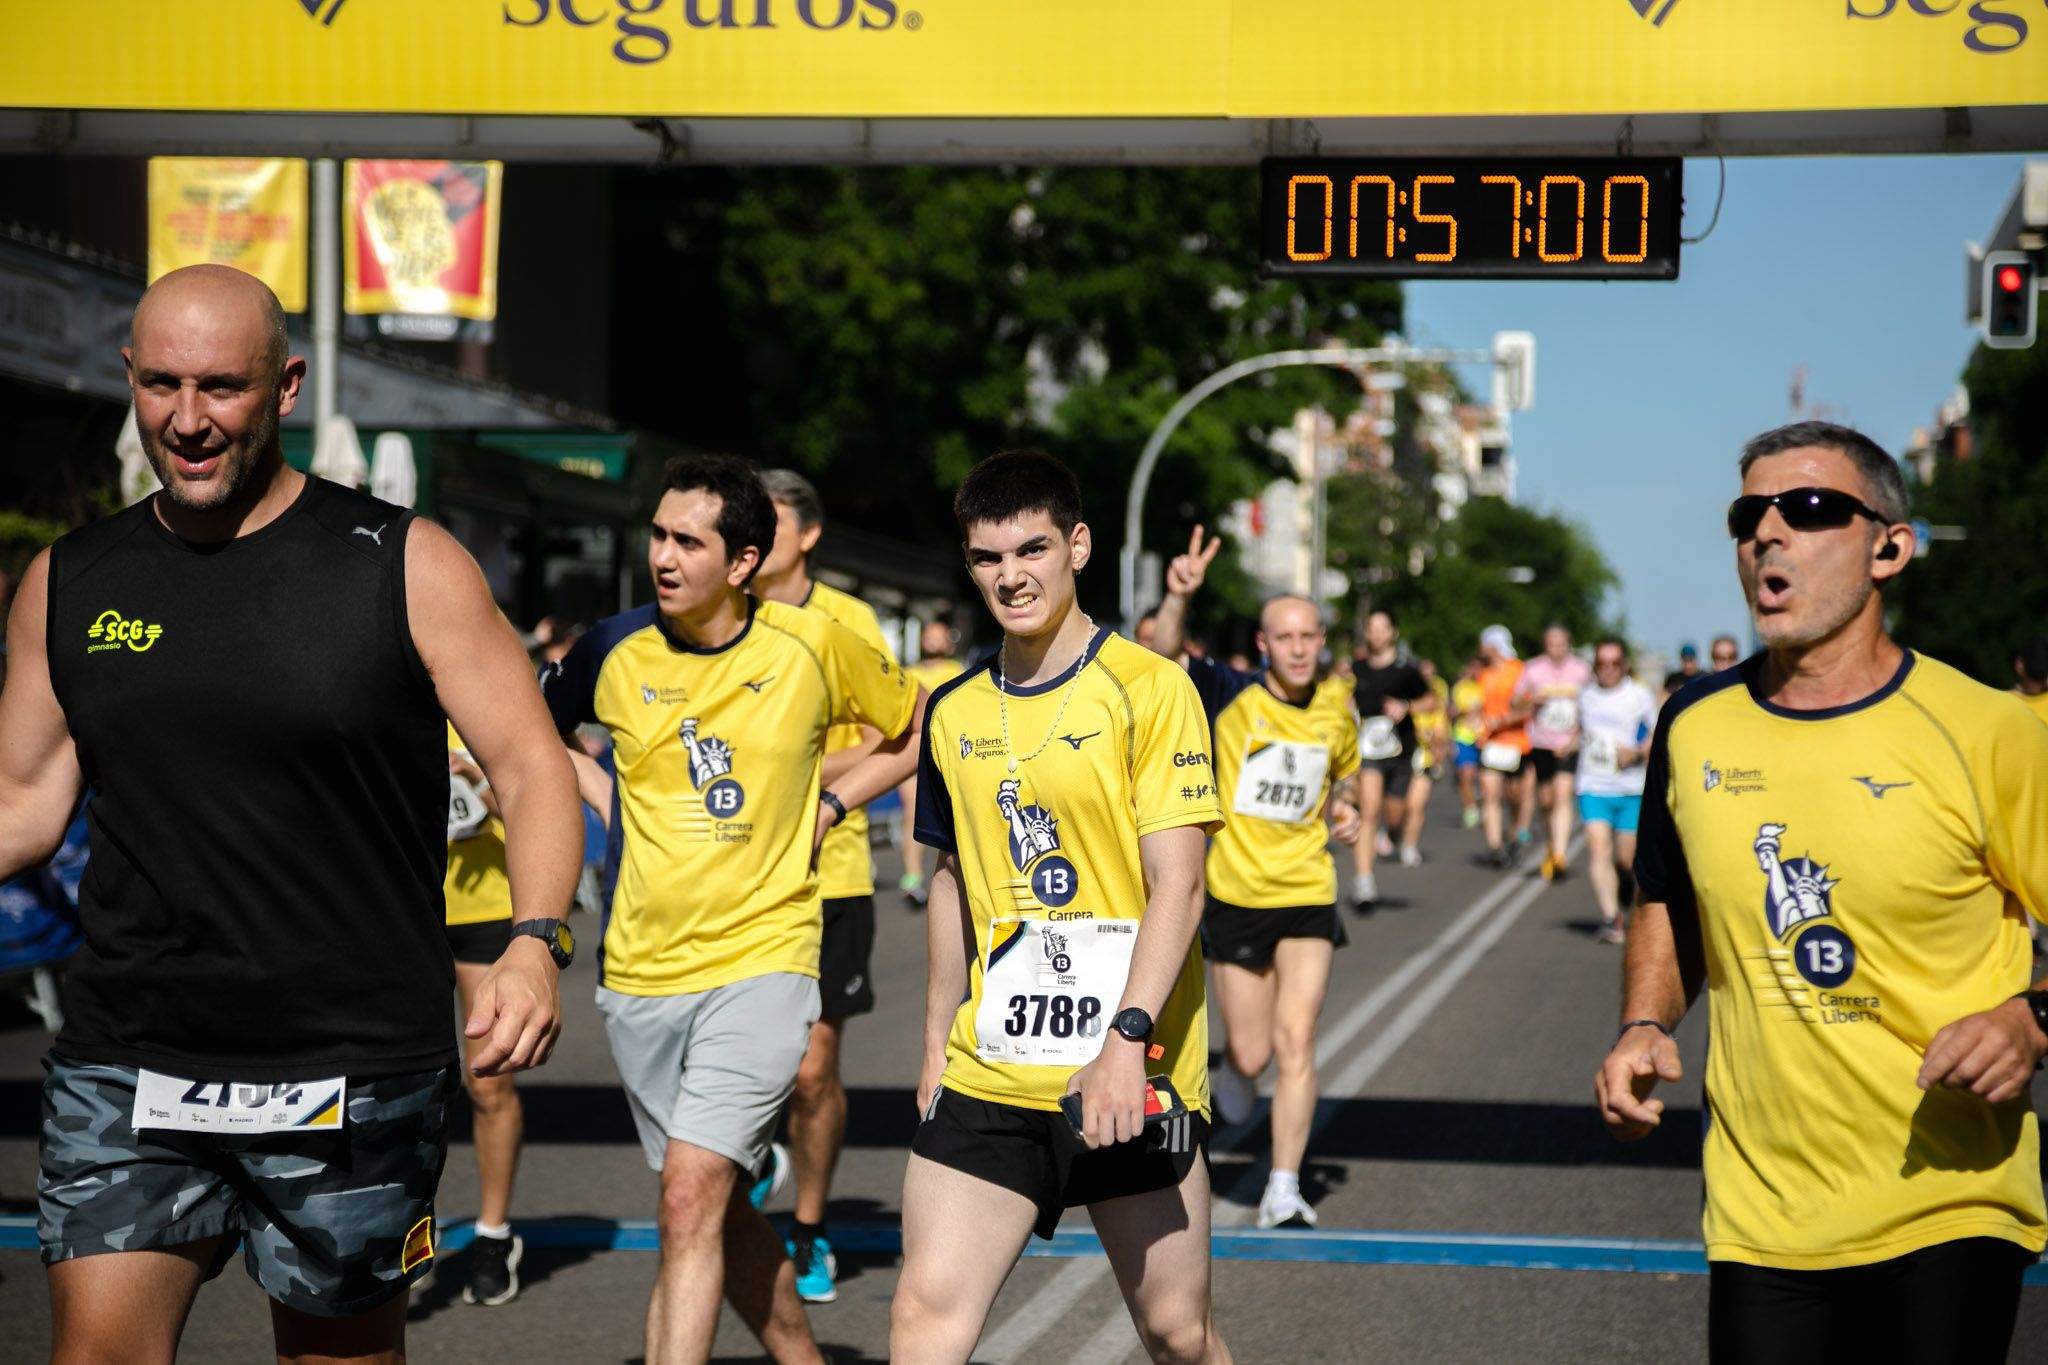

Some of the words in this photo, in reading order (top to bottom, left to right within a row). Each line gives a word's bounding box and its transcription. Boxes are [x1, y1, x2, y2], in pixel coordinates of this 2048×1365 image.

[105, 620, 143, 642] SCG
[87, 642, 121, 654] gimnasio
[975, 738, 1003, 747] Liberty
[1726, 768, 1762, 779] Liberty
[712, 787, 738, 810] 13
[1256, 780, 1306, 808] 2873
[715, 821, 754, 832] Carrera
[715, 832, 753, 845] Liberty
[1041, 868, 1069, 894] 13
[1048, 909, 1094, 921] Carrera
[1056, 958, 1069, 969] 13
[1804, 940, 1844, 974] 13
[1818, 992, 1880, 1008] Carrera
[1005, 994, 1101, 1039] 3788
[1822, 1009, 1882, 1025] Liberty
